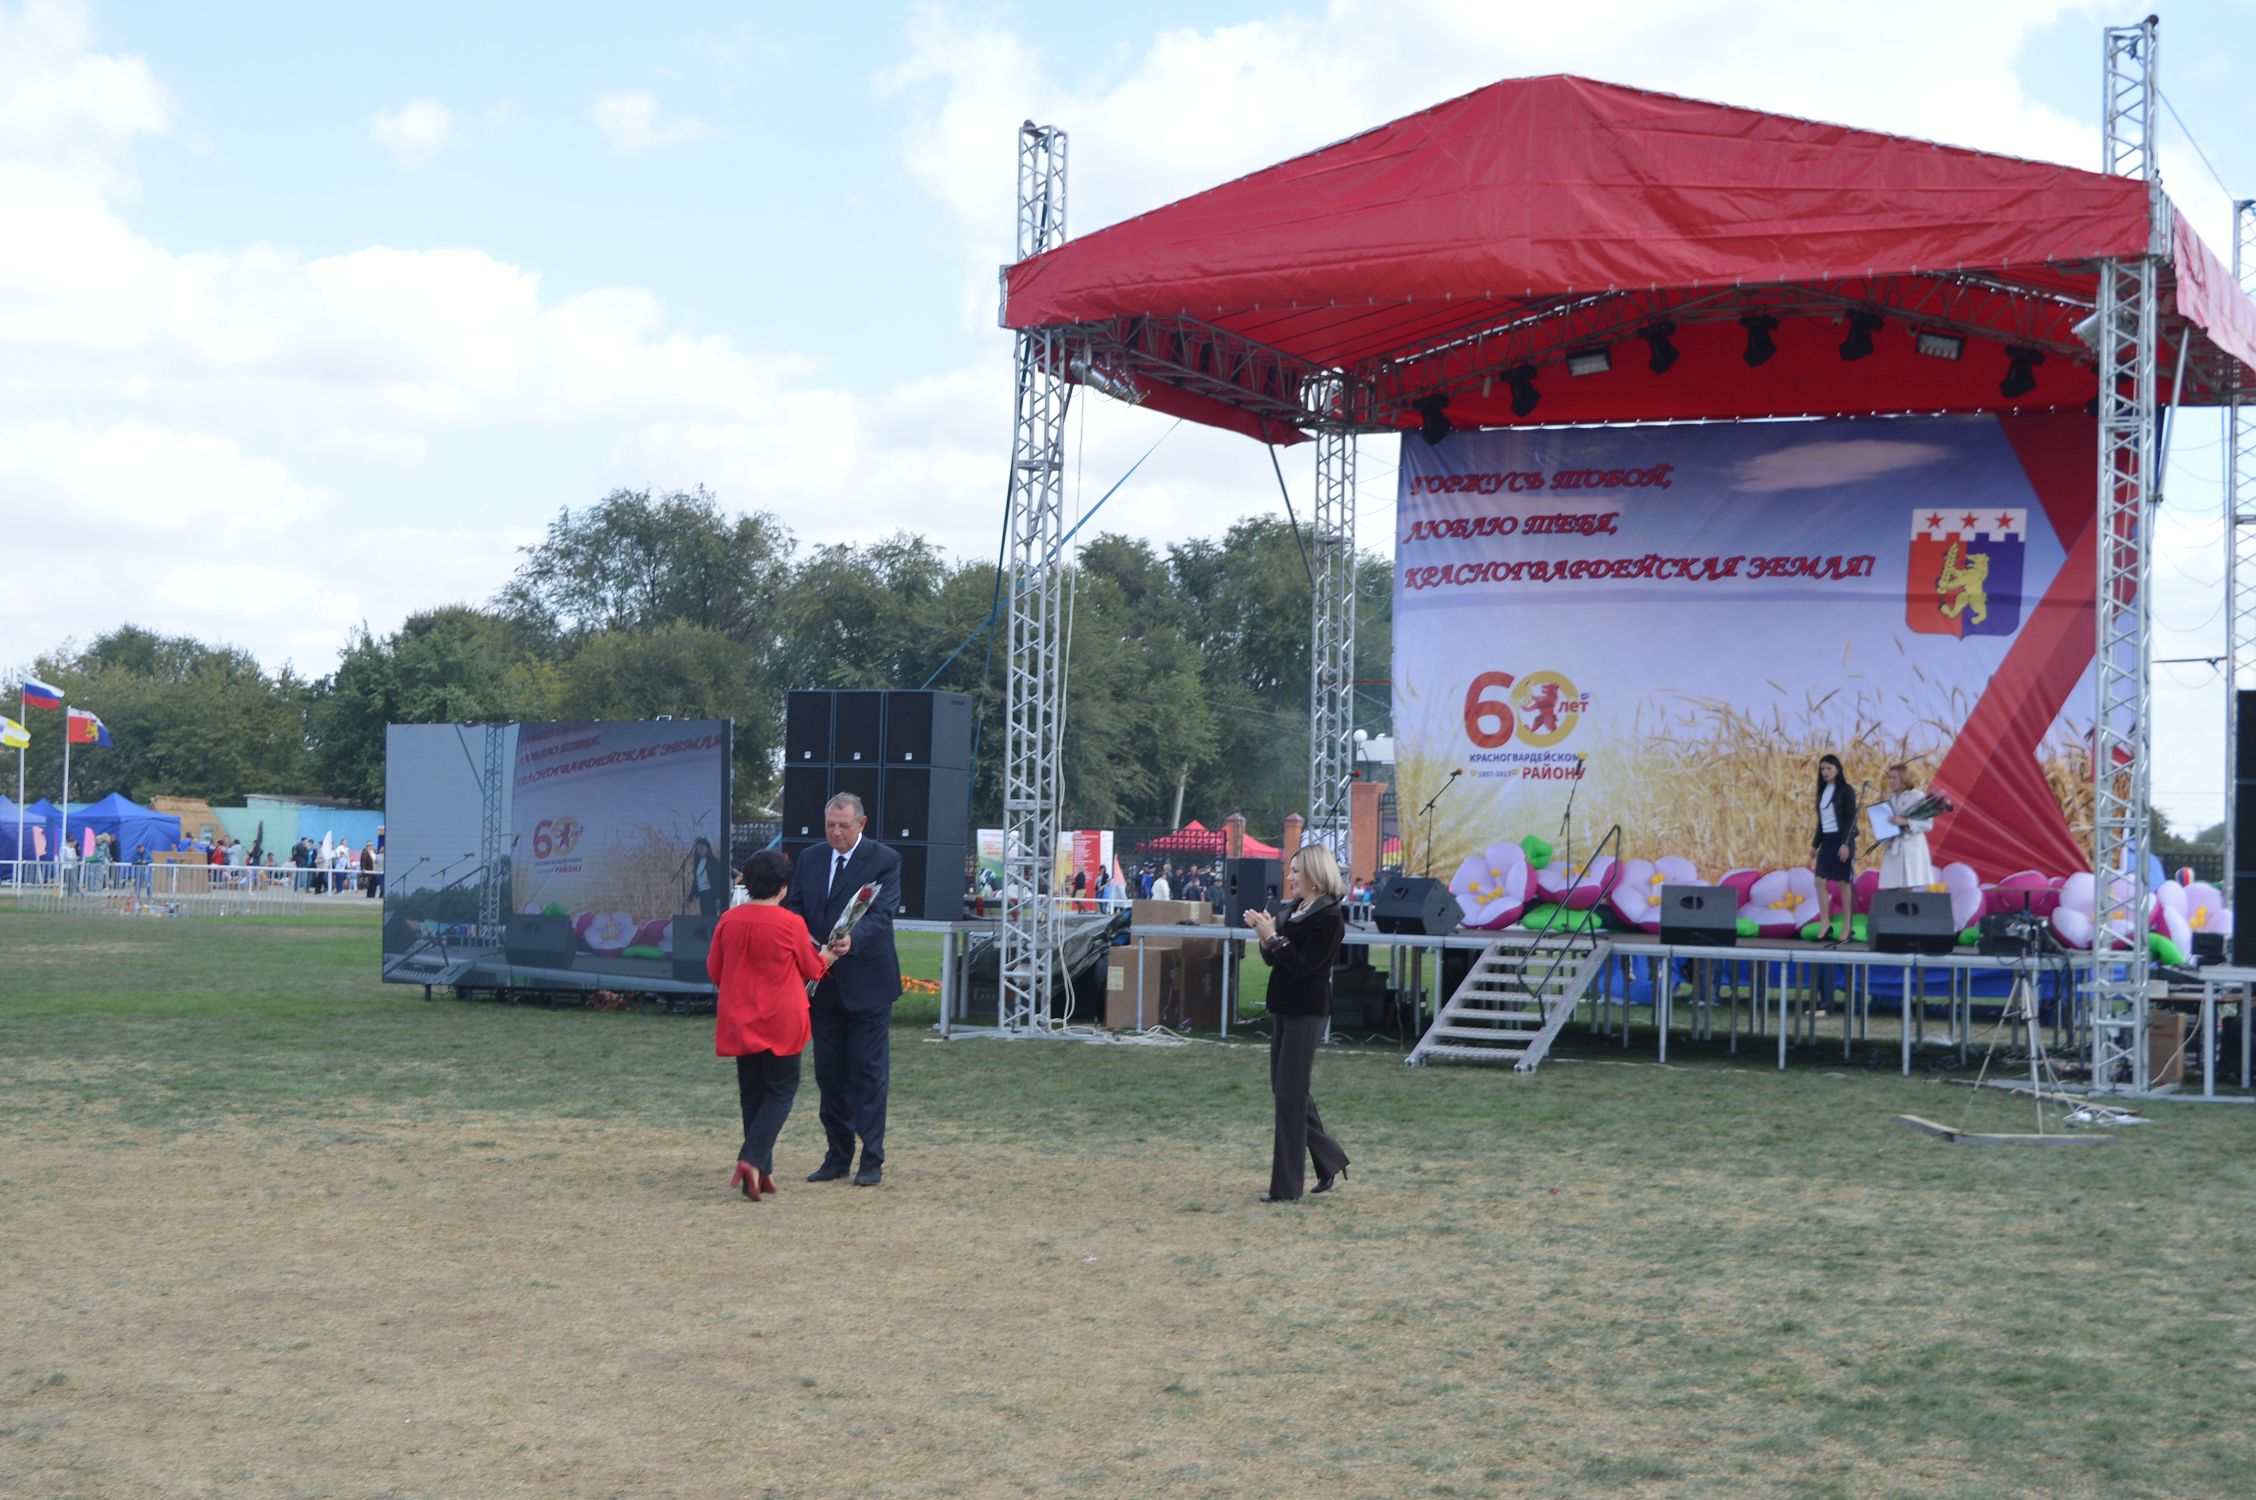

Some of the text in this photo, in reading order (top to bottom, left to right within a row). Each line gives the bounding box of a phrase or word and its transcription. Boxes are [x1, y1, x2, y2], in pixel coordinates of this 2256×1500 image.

[1402, 512, 1620, 545] ЛЮБЛЮ ТЕБЯ,
[1404, 553, 1877, 591] КРАСНОГВАРДЕЙСКАЯ ЗЕМЛЯ!
[1464, 670, 1590, 749] 60 лет
[1469, 750, 1582, 764] КРАСНОГВАРДЕЙСКОМ
